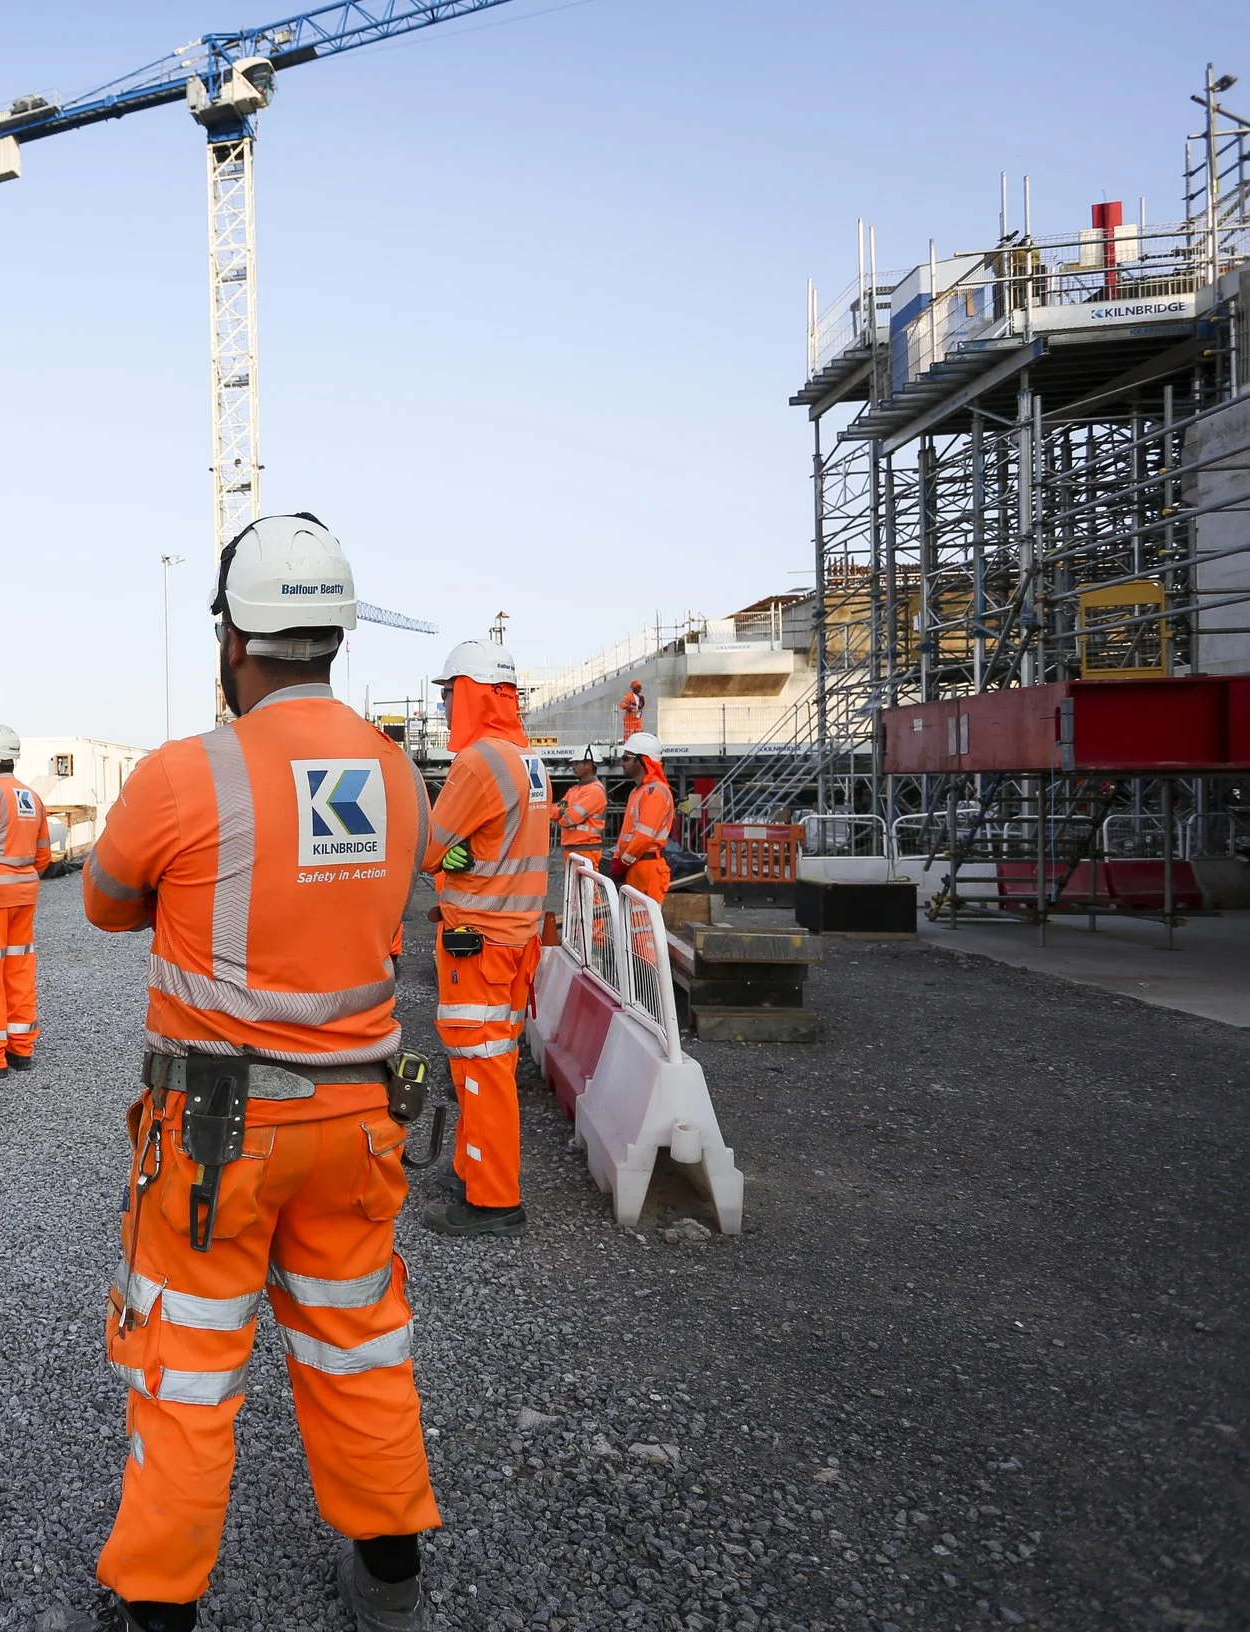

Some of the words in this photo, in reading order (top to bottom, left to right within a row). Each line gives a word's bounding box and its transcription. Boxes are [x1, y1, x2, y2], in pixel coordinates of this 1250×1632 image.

[1105, 302, 1186, 318] KILNBRIDGE
[281, 584, 318, 595] Balfour
[320, 583, 345, 595] Beatty
[313, 841, 378, 855] KILNBRIDGE
[297, 871, 336, 883] Safety
[338, 870, 350, 880] in
[352, 868, 387, 880] Action
